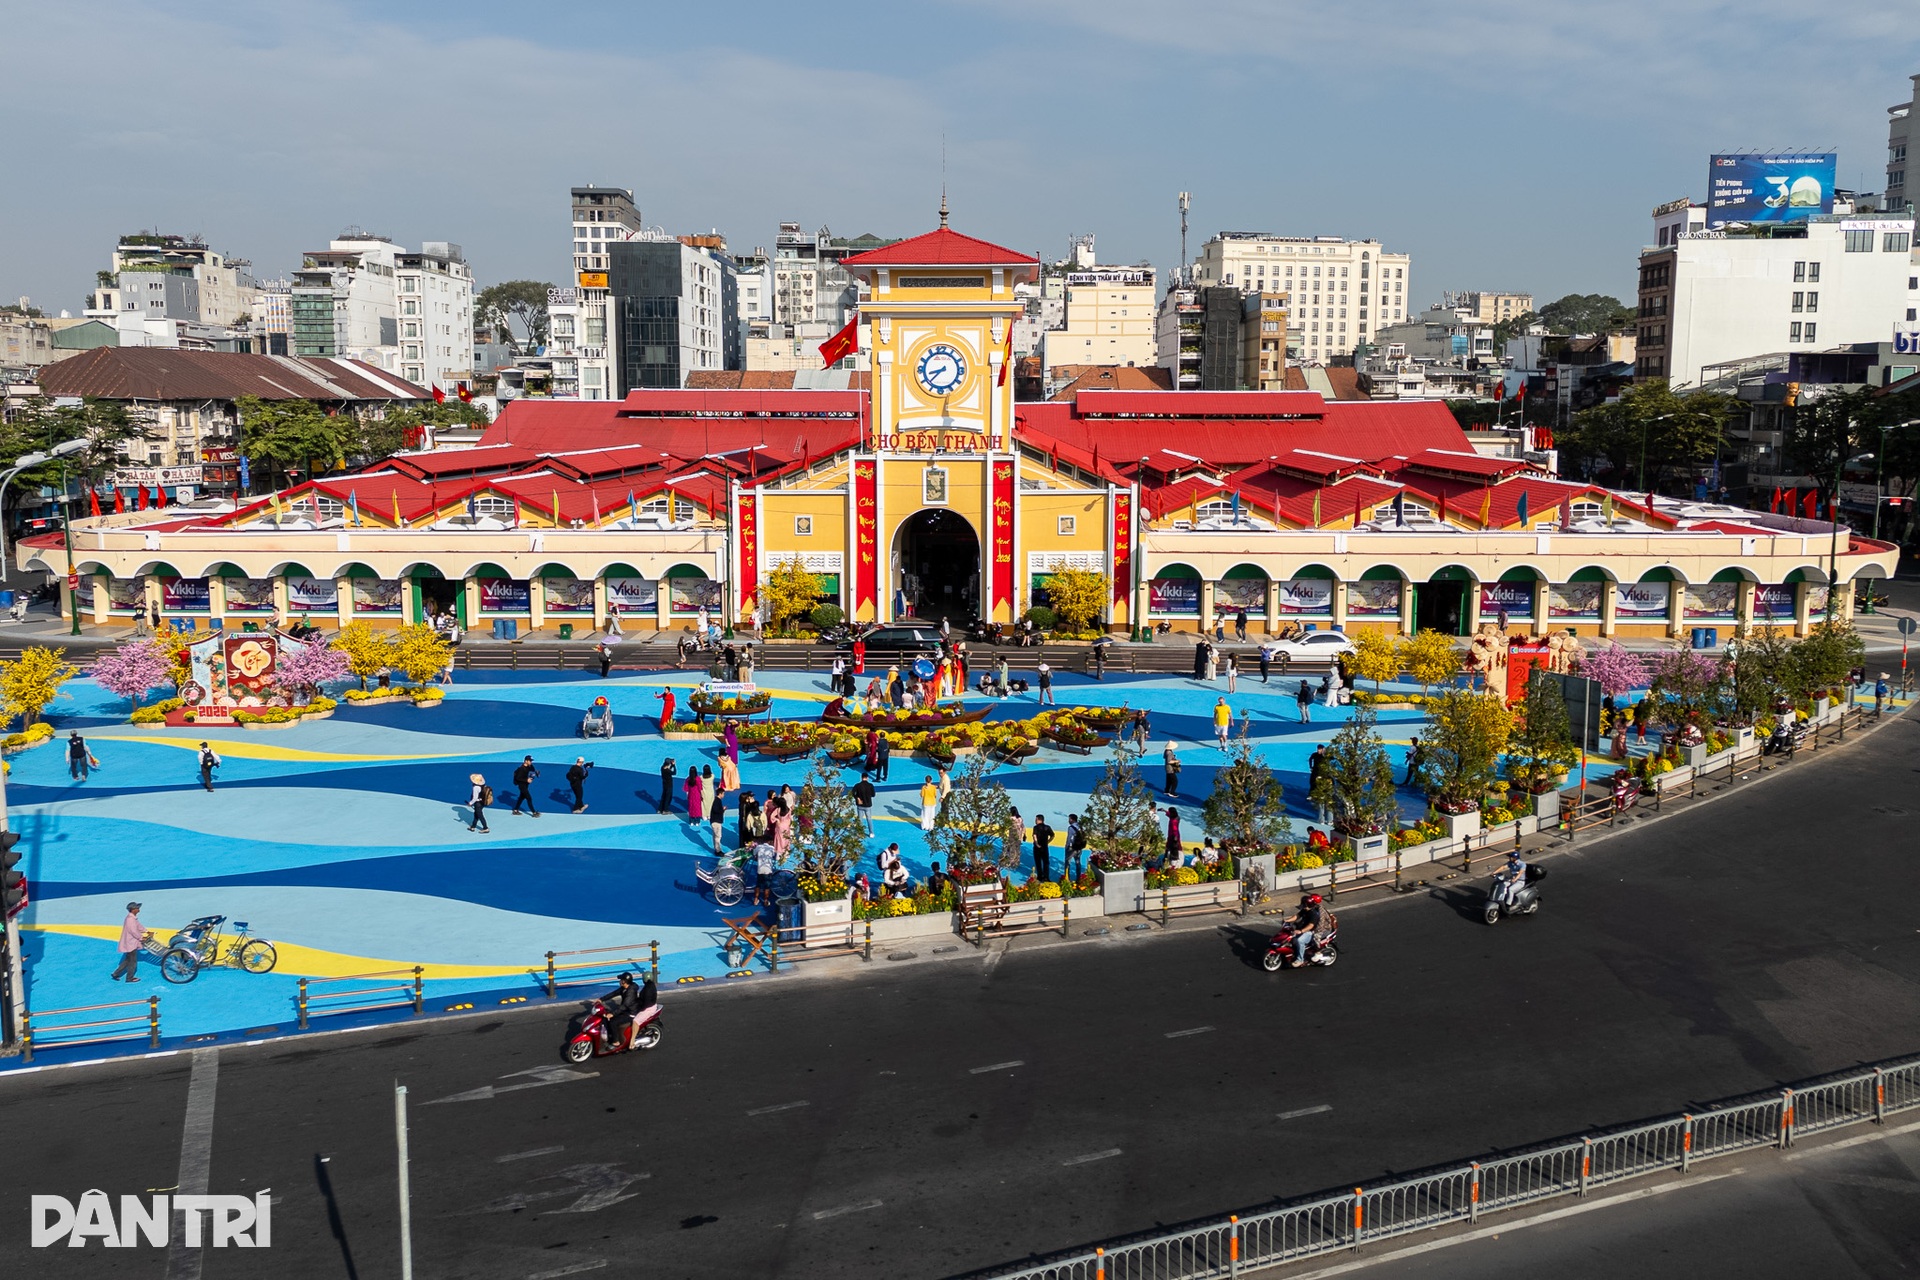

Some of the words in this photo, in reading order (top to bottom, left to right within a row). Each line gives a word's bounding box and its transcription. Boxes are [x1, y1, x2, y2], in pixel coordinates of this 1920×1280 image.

[1763, 176, 1822, 209] 30
[1677, 231, 1708, 239] OZONE
[1710, 231, 1727, 239] BAR
[547, 296, 564, 304] SPA
[865, 432, 900, 450] CHỢ
[905, 429, 937, 449] BẾN
[944, 431, 1003, 449] THÀNH
[171, 469, 183, 479] HÀ
[166, 579, 195, 595] Vikki
[292, 580, 321, 595] Vikki
[483, 580, 512, 596] Vikki
[611, 580, 640, 596] Vikki
[1153, 581, 1182, 597] Vikki
[1284, 582, 1313, 598] Vikki
[1484, 584, 1514, 600] Vikki
[1620, 585, 1649, 600] Vikki
[1757, 587, 1780, 600] Vikki
[198, 706, 228, 717] 2026
